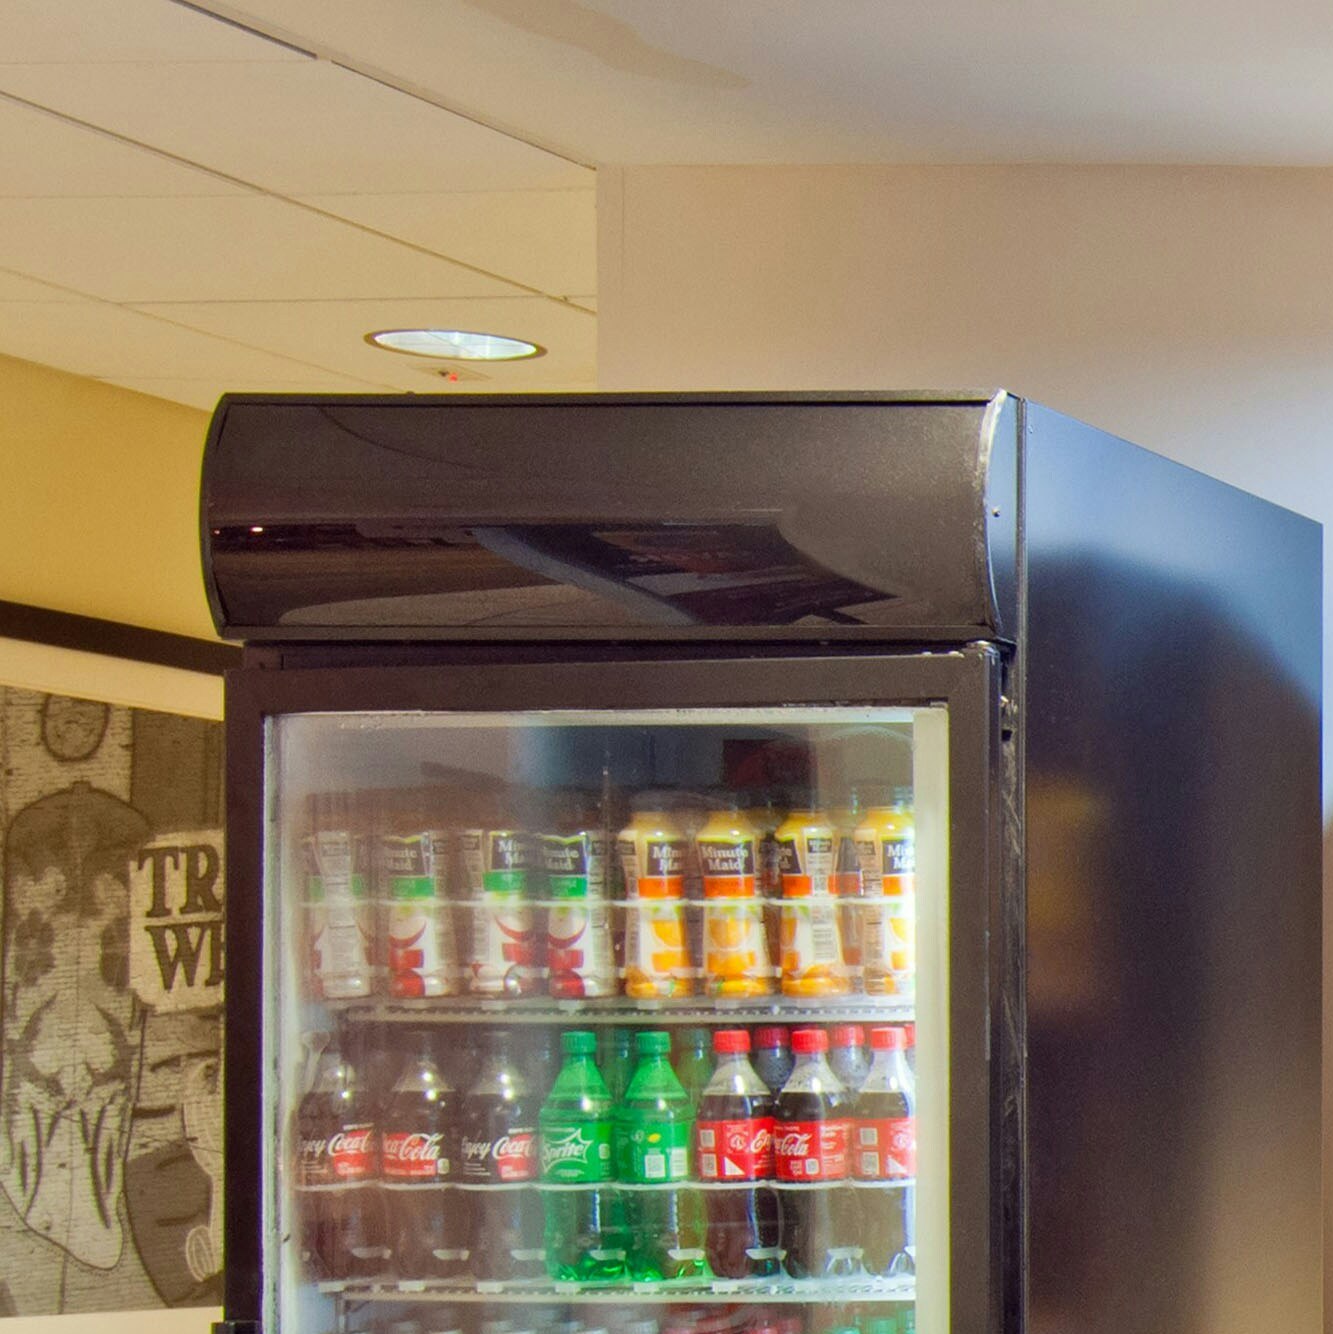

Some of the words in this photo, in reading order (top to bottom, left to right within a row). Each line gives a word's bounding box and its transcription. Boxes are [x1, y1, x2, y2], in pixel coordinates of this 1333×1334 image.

[701, 846, 748, 859] Minute
[707, 857, 744, 871] Maid
[400, 1132, 443, 1161] Cola
